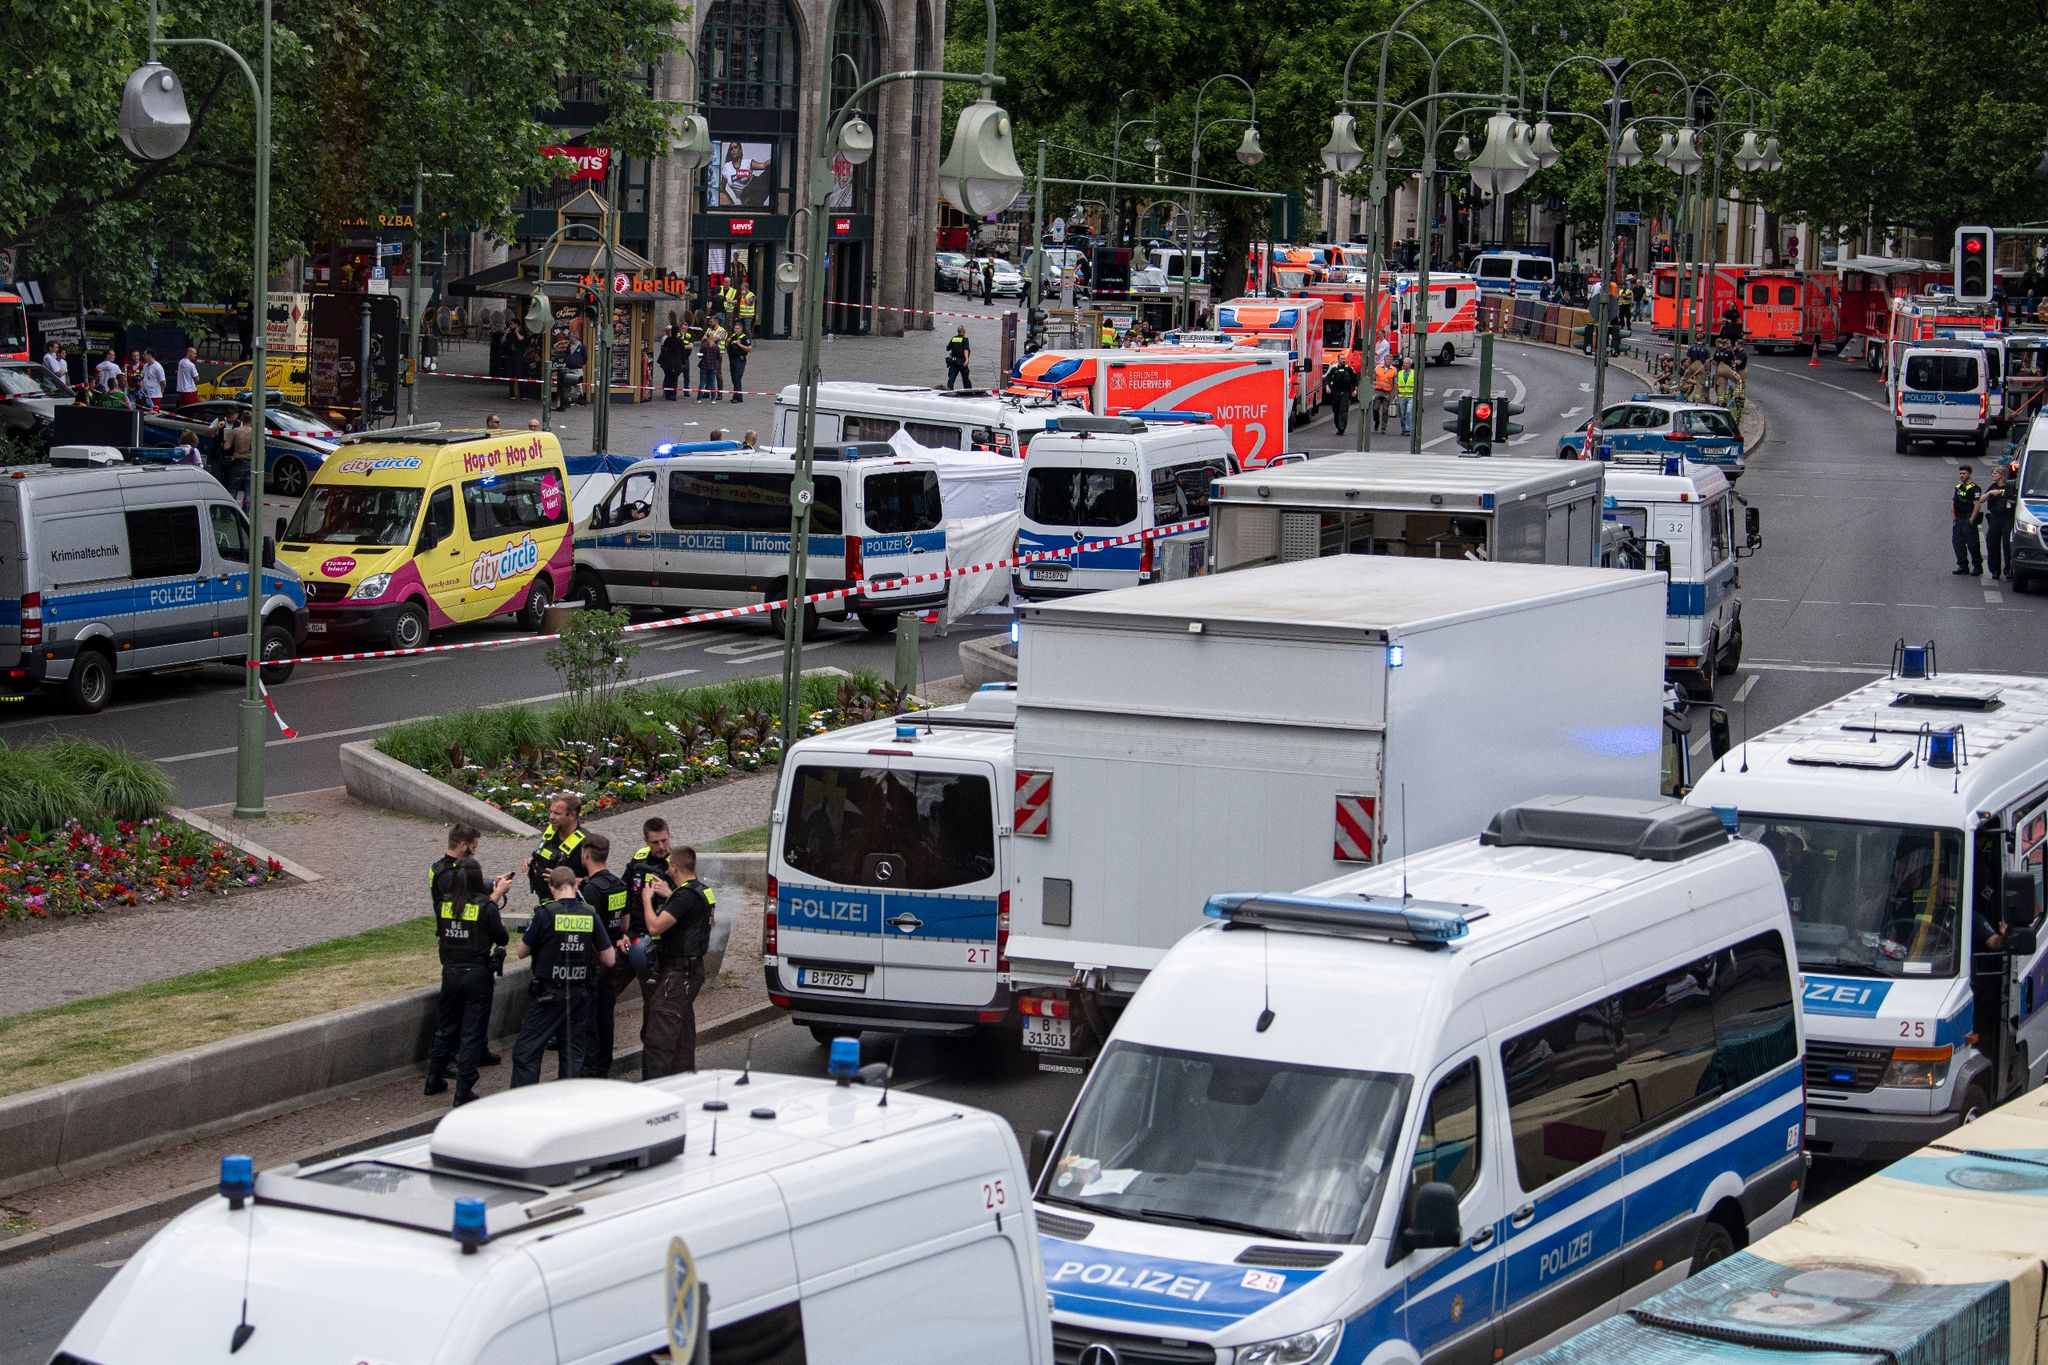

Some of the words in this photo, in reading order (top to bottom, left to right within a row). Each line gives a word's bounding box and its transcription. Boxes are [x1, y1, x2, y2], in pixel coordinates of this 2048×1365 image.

[632, 275, 685, 295] berlin
[1753, 304, 1793, 313] FEUERWEHR
[1777, 321, 1796, 331] 112
[1129, 371, 1159, 379] BERLINER
[1129, 379, 1172, 389] FEUERWEHR
[1904, 393, 1936, 401] POLIZEI
[1217, 404, 1268, 419] NOTRUF
[463, 452, 486, 473] Hop
[487, 449, 501, 464] on
[505, 446, 527, 467] Hop
[528, 437, 543, 459] off
[541, 485, 560, 499] Tickets
[679, 534, 725, 549] POLIZEI
[866, 539, 903, 553] POLIZEI
[51, 544, 120, 563] Kriminaltechnik
[325, 559, 355, 567] Tickets
[150, 584, 197, 606] POLIZEI
[790, 898, 868, 922] POLIZEI
[451, 921, 462, 930] BE
[556, 916, 593, 931] POLIZEI
[445, 929, 469, 939] 25218
[568, 934, 579, 943] BE
[560, 943, 585, 951] 25216
[552, 965, 587, 980] POLIZEI
[811, 972, 819, 984] B
[826, 973, 854, 987] 7875
[1042, 1019, 1050, 1031] B
[1028, 1031, 1066, 1047] 31303
[983, 1179, 1006, 1210] 25
[1539, 1229, 1593, 1281] POLIZEI
[1053, 1261, 1212, 1302] POLIZEI
